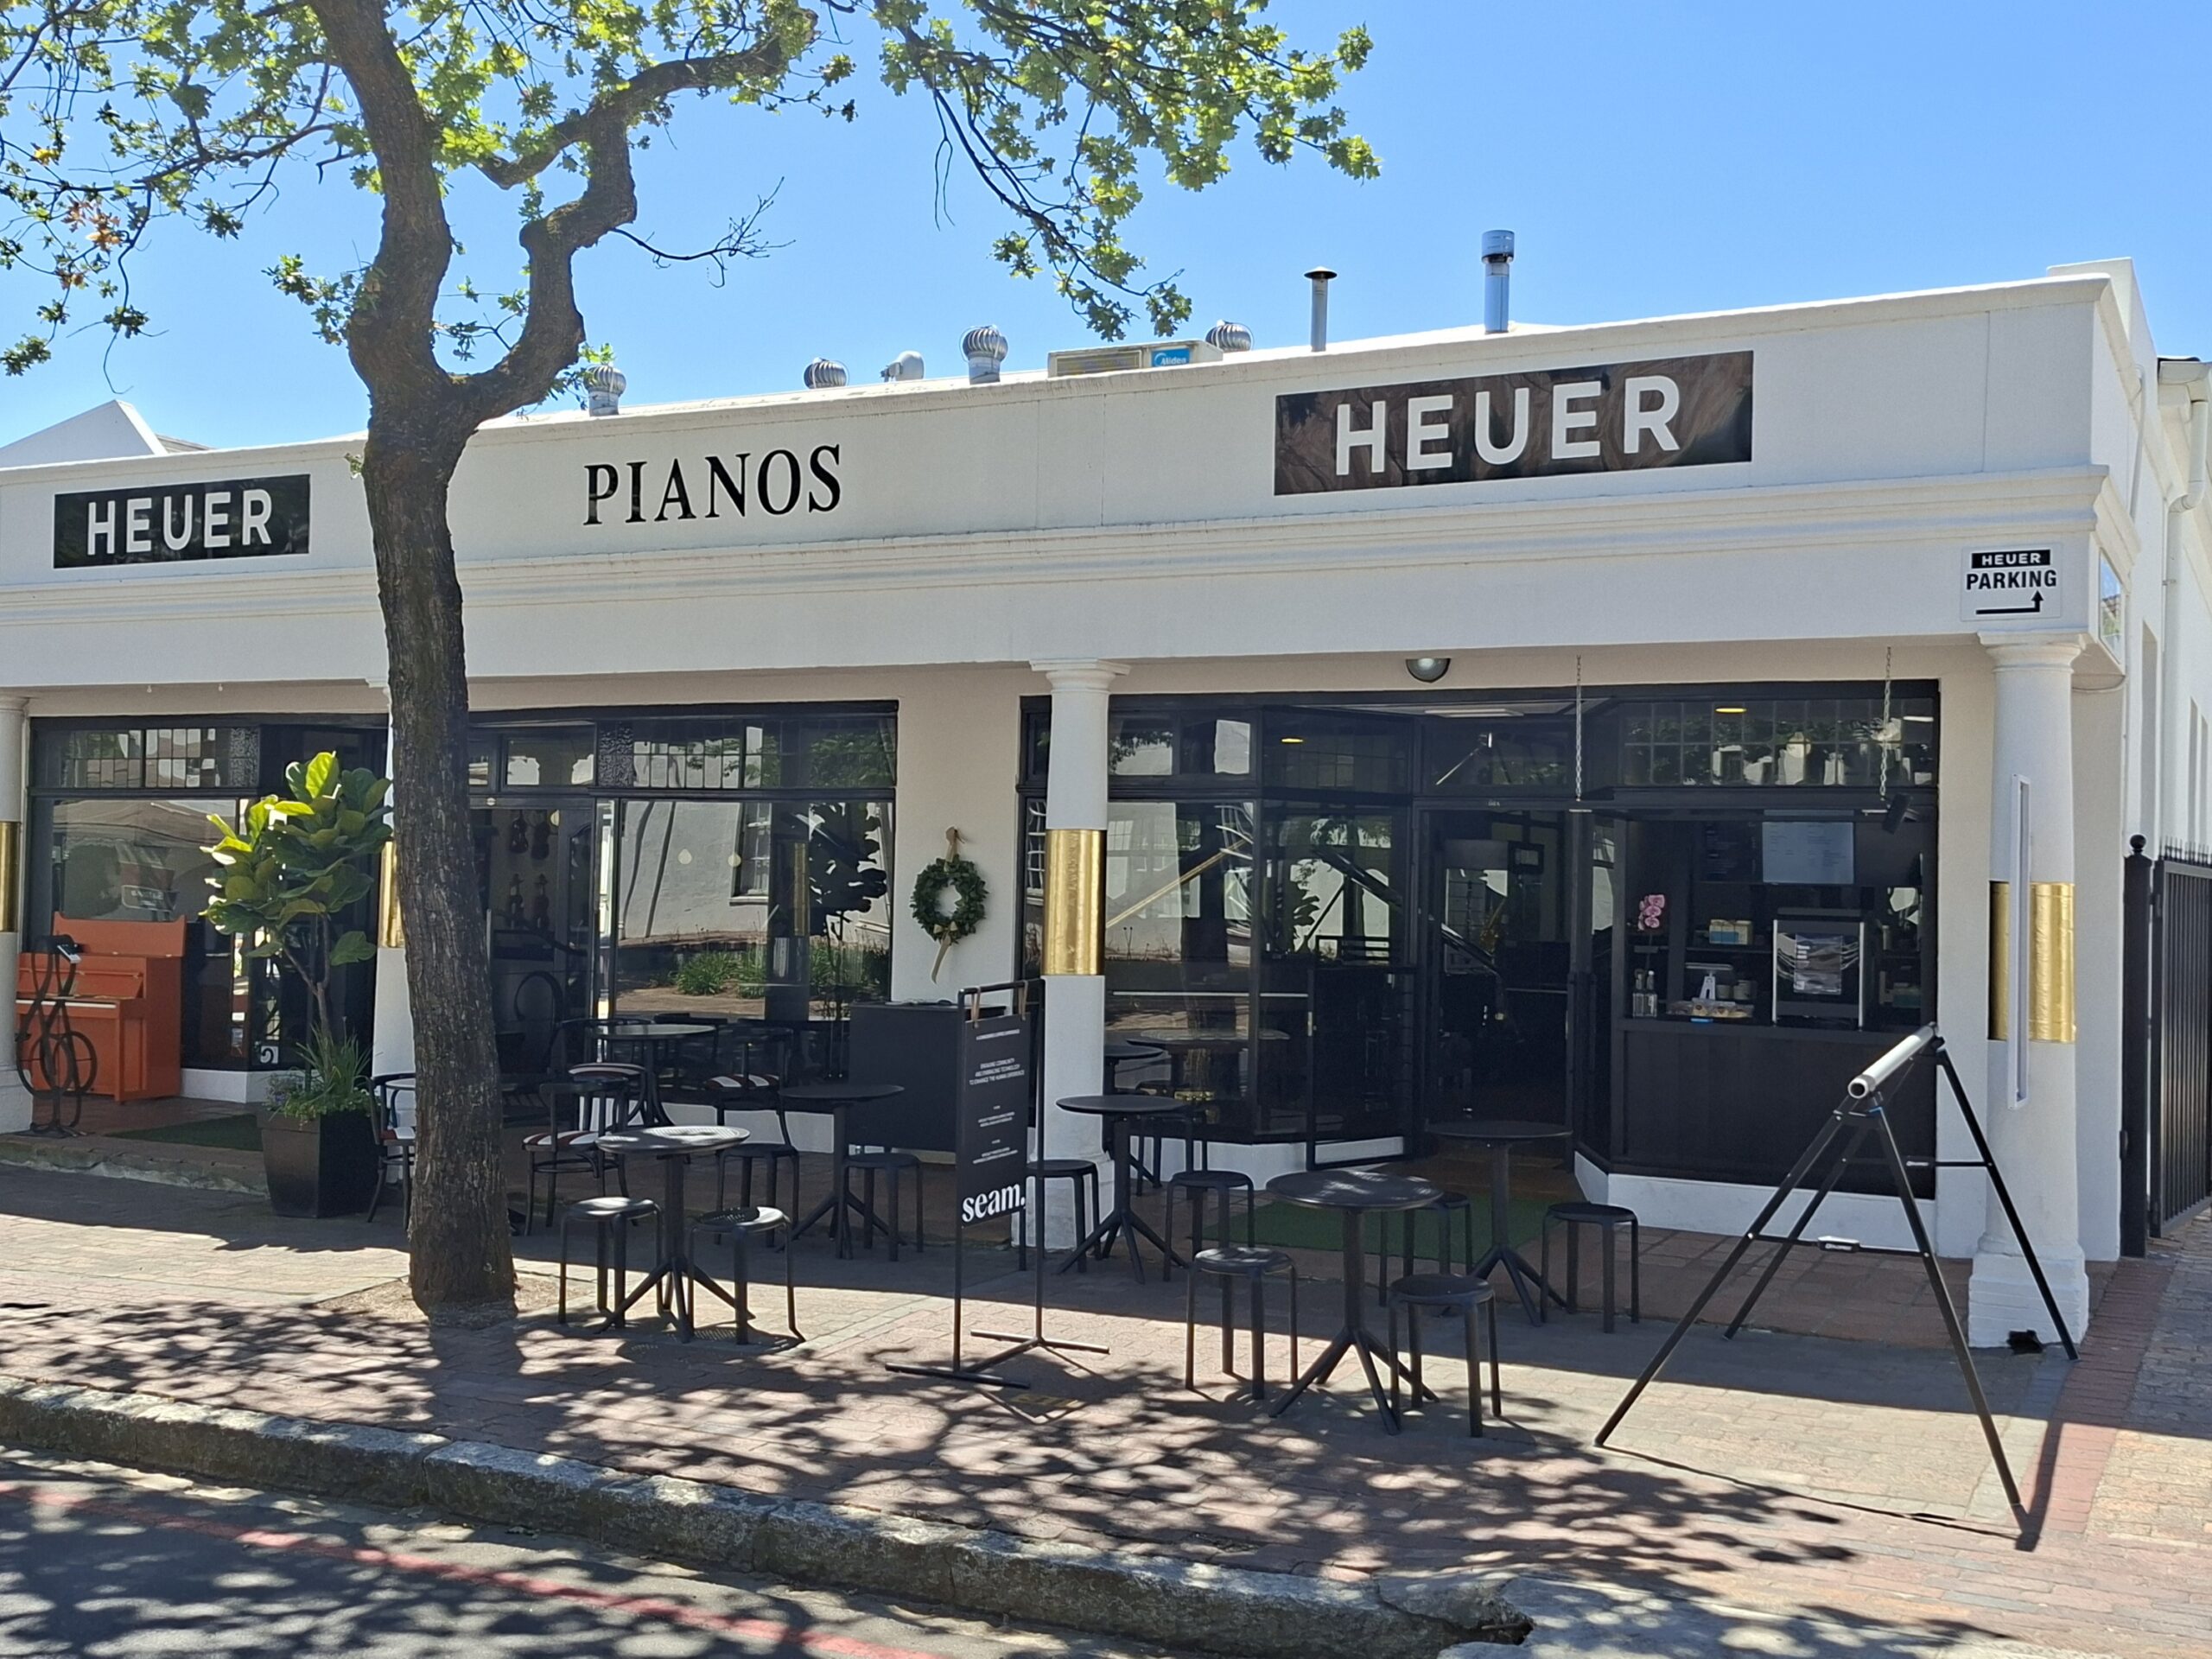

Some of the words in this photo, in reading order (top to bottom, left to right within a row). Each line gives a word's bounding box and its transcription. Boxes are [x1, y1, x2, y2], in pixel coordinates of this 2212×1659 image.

[1335, 374, 1681, 477] HEUER
[582, 443, 842, 525] PIANOS
[87, 488, 272, 556] HEUER
[1966, 569, 2057, 590] PARKING
[1981, 552, 2042, 566] HEUER
[962, 1183, 1026, 1223] seam.
